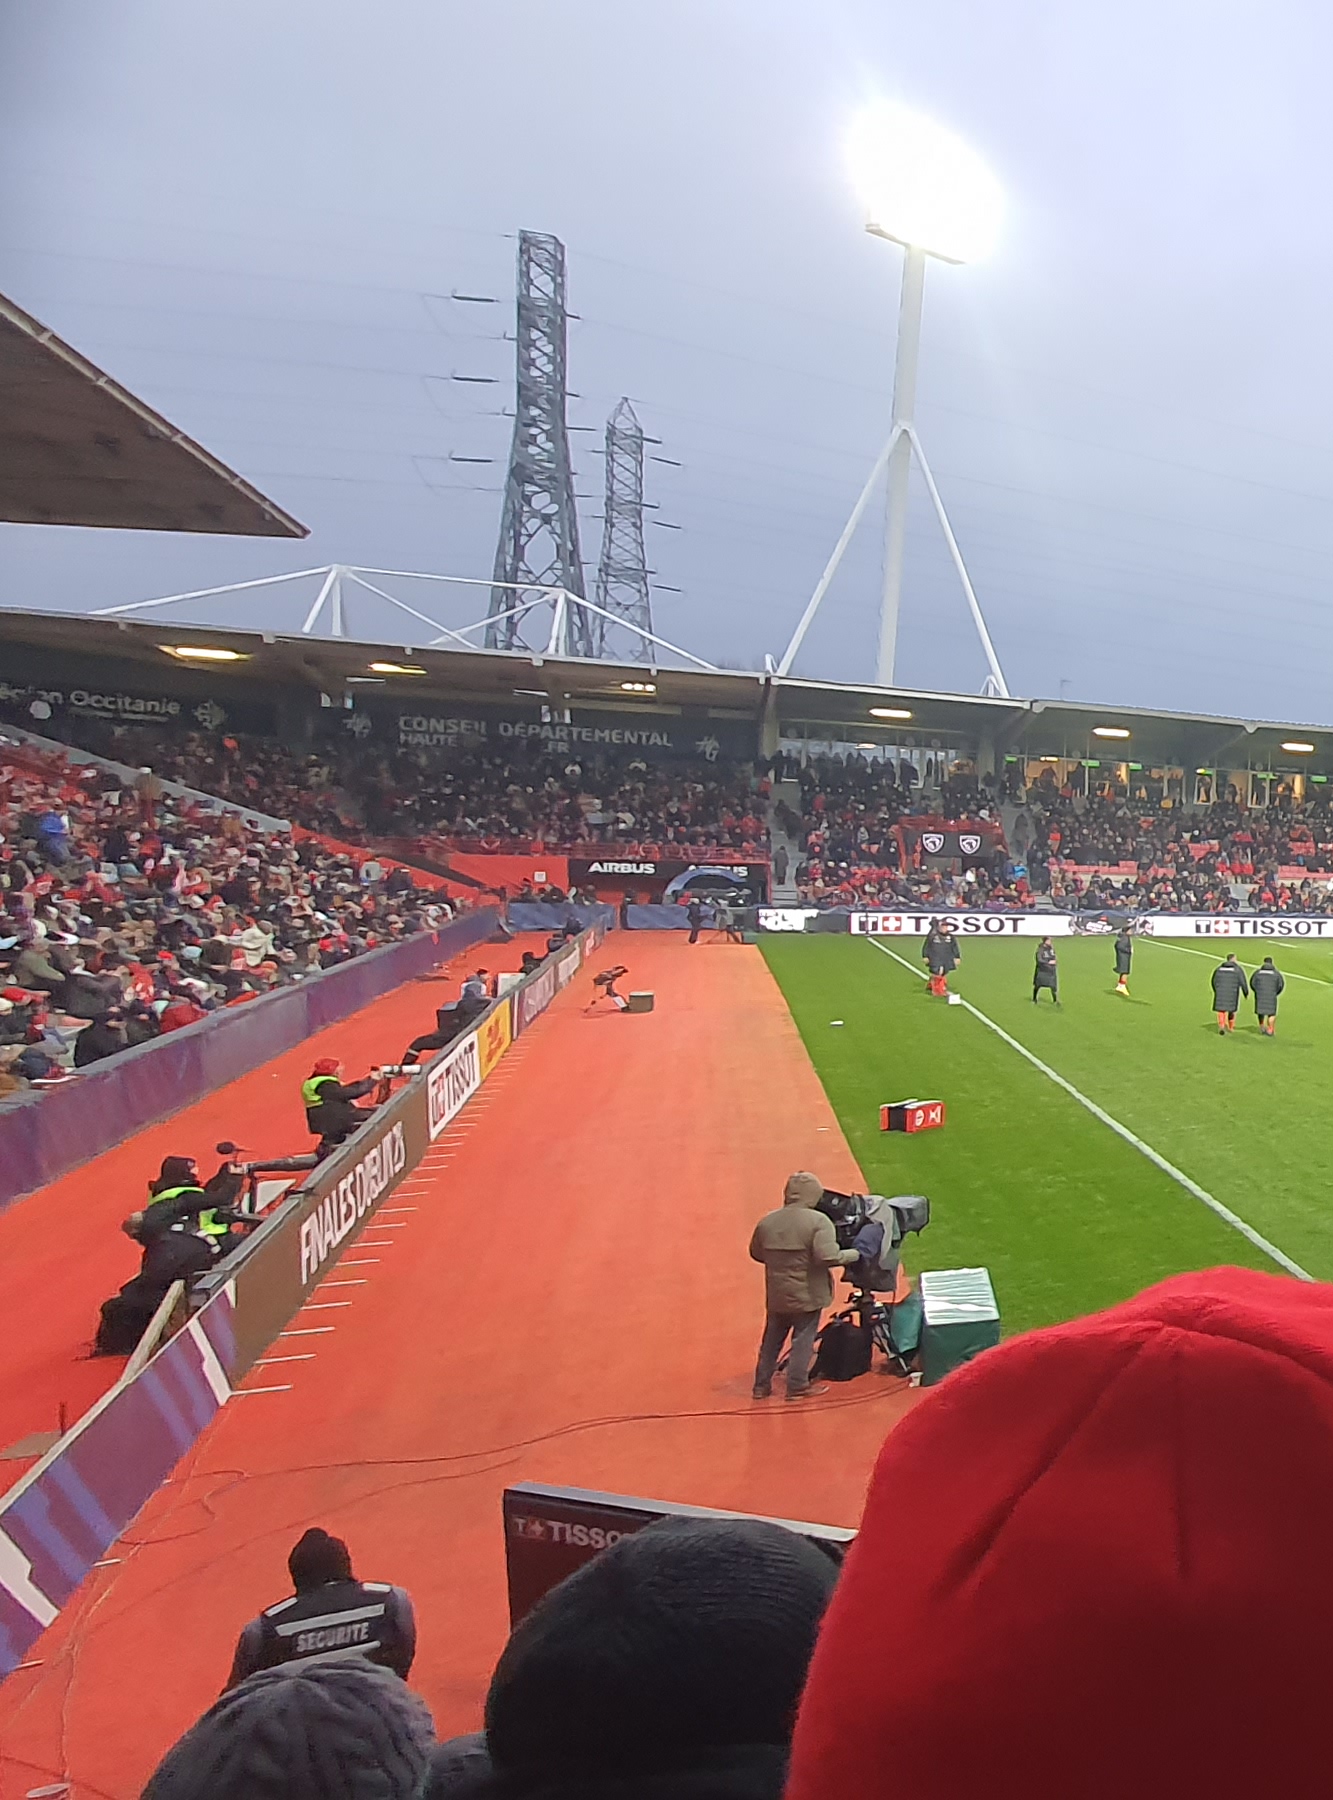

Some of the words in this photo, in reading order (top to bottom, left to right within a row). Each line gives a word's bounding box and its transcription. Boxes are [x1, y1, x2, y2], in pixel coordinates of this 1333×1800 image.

[69, 690, 181, 714] Occitanie
[588, 861, 656, 875] AIRBUS
[907, 916, 1026, 933] TSSOT
[1232, 920, 1328, 935] TISSOT
[301, 1171, 356, 1285] FINALES
[548, 1520, 628, 1549] TISSO
